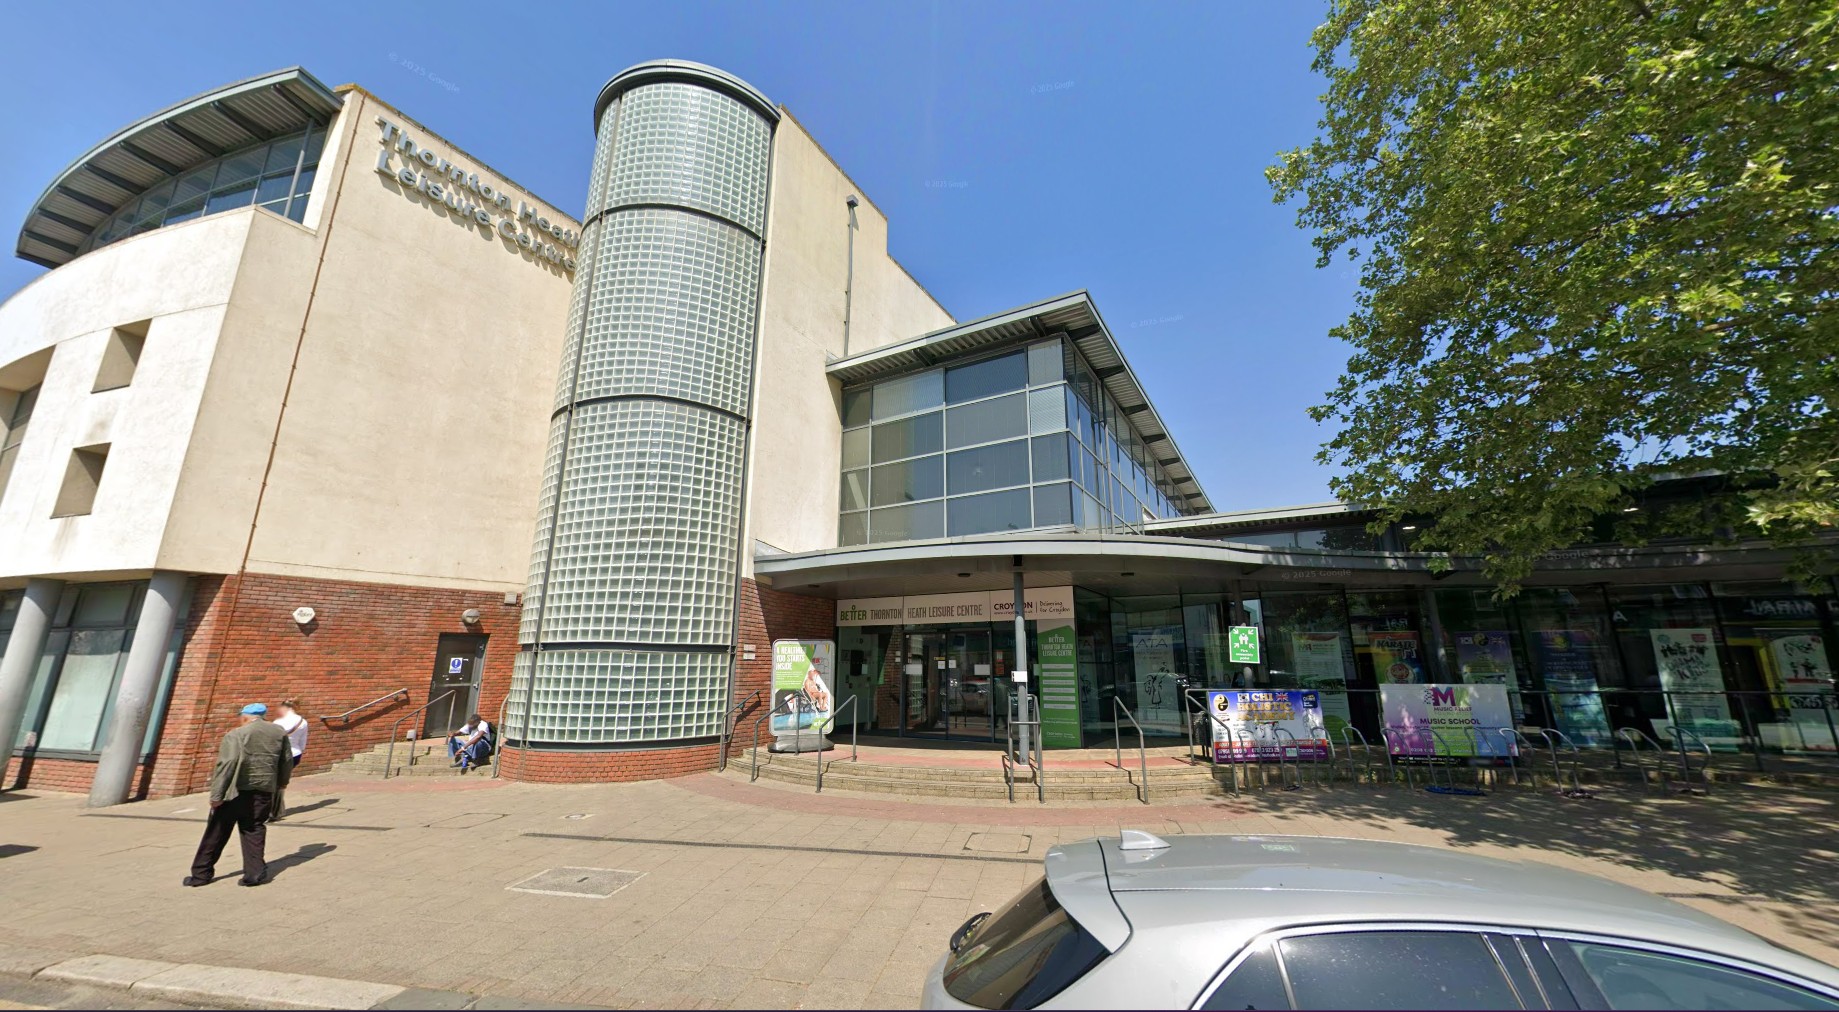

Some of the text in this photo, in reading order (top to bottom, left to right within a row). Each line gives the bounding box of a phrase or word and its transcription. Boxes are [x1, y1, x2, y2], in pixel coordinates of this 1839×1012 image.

[375, 115, 512, 211] Thornton
[374, 149, 491, 226] Leisure
[840, 604, 982, 620] BETTER THORNTON HEATH LEISURE CENTRE
[1251, 693, 1273, 701] CHI
[1237, 702, 1292, 711] HOLISTIC
